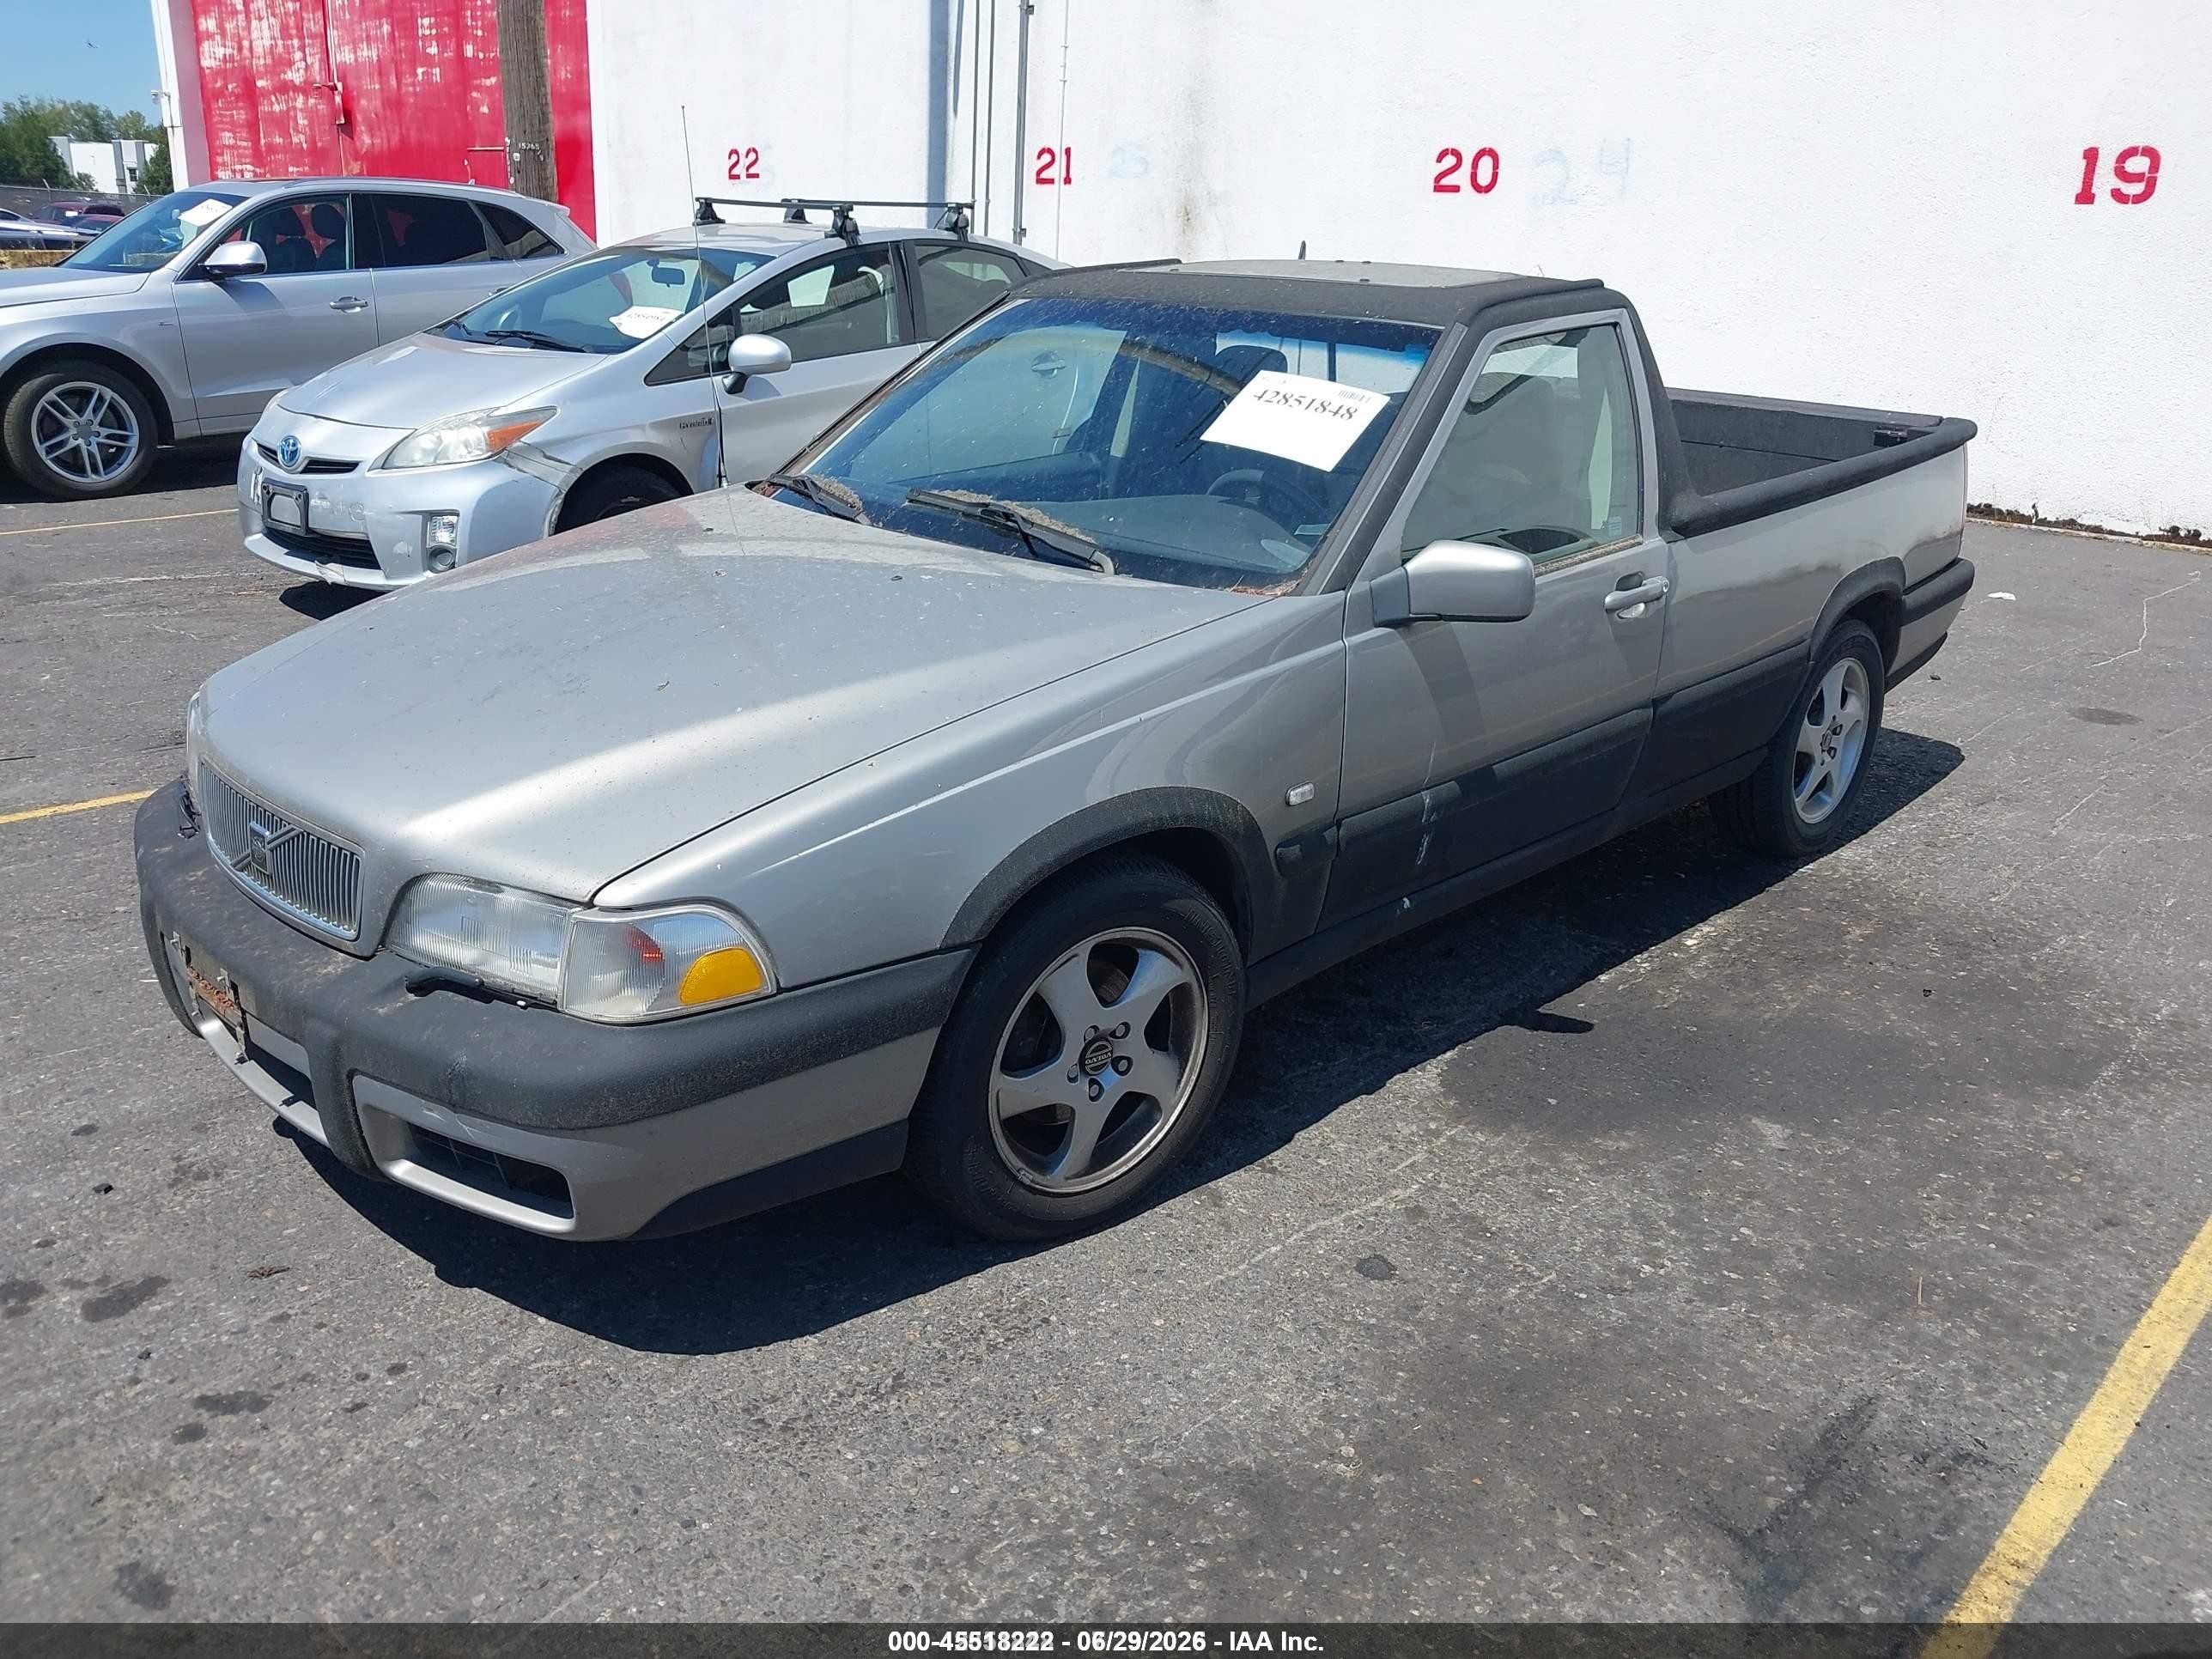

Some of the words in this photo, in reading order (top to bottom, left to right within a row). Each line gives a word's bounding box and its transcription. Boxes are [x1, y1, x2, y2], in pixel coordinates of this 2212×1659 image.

[727, 147, 760, 179] 22
[1036, 147, 1072, 185] 21
[1432, 148, 1499, 193] 20
[2074, 145, 2161, 205] 19
[1253, 389, 1358, 421] 42851848
[1085, 1052, 1112, 1065] VOLVO
